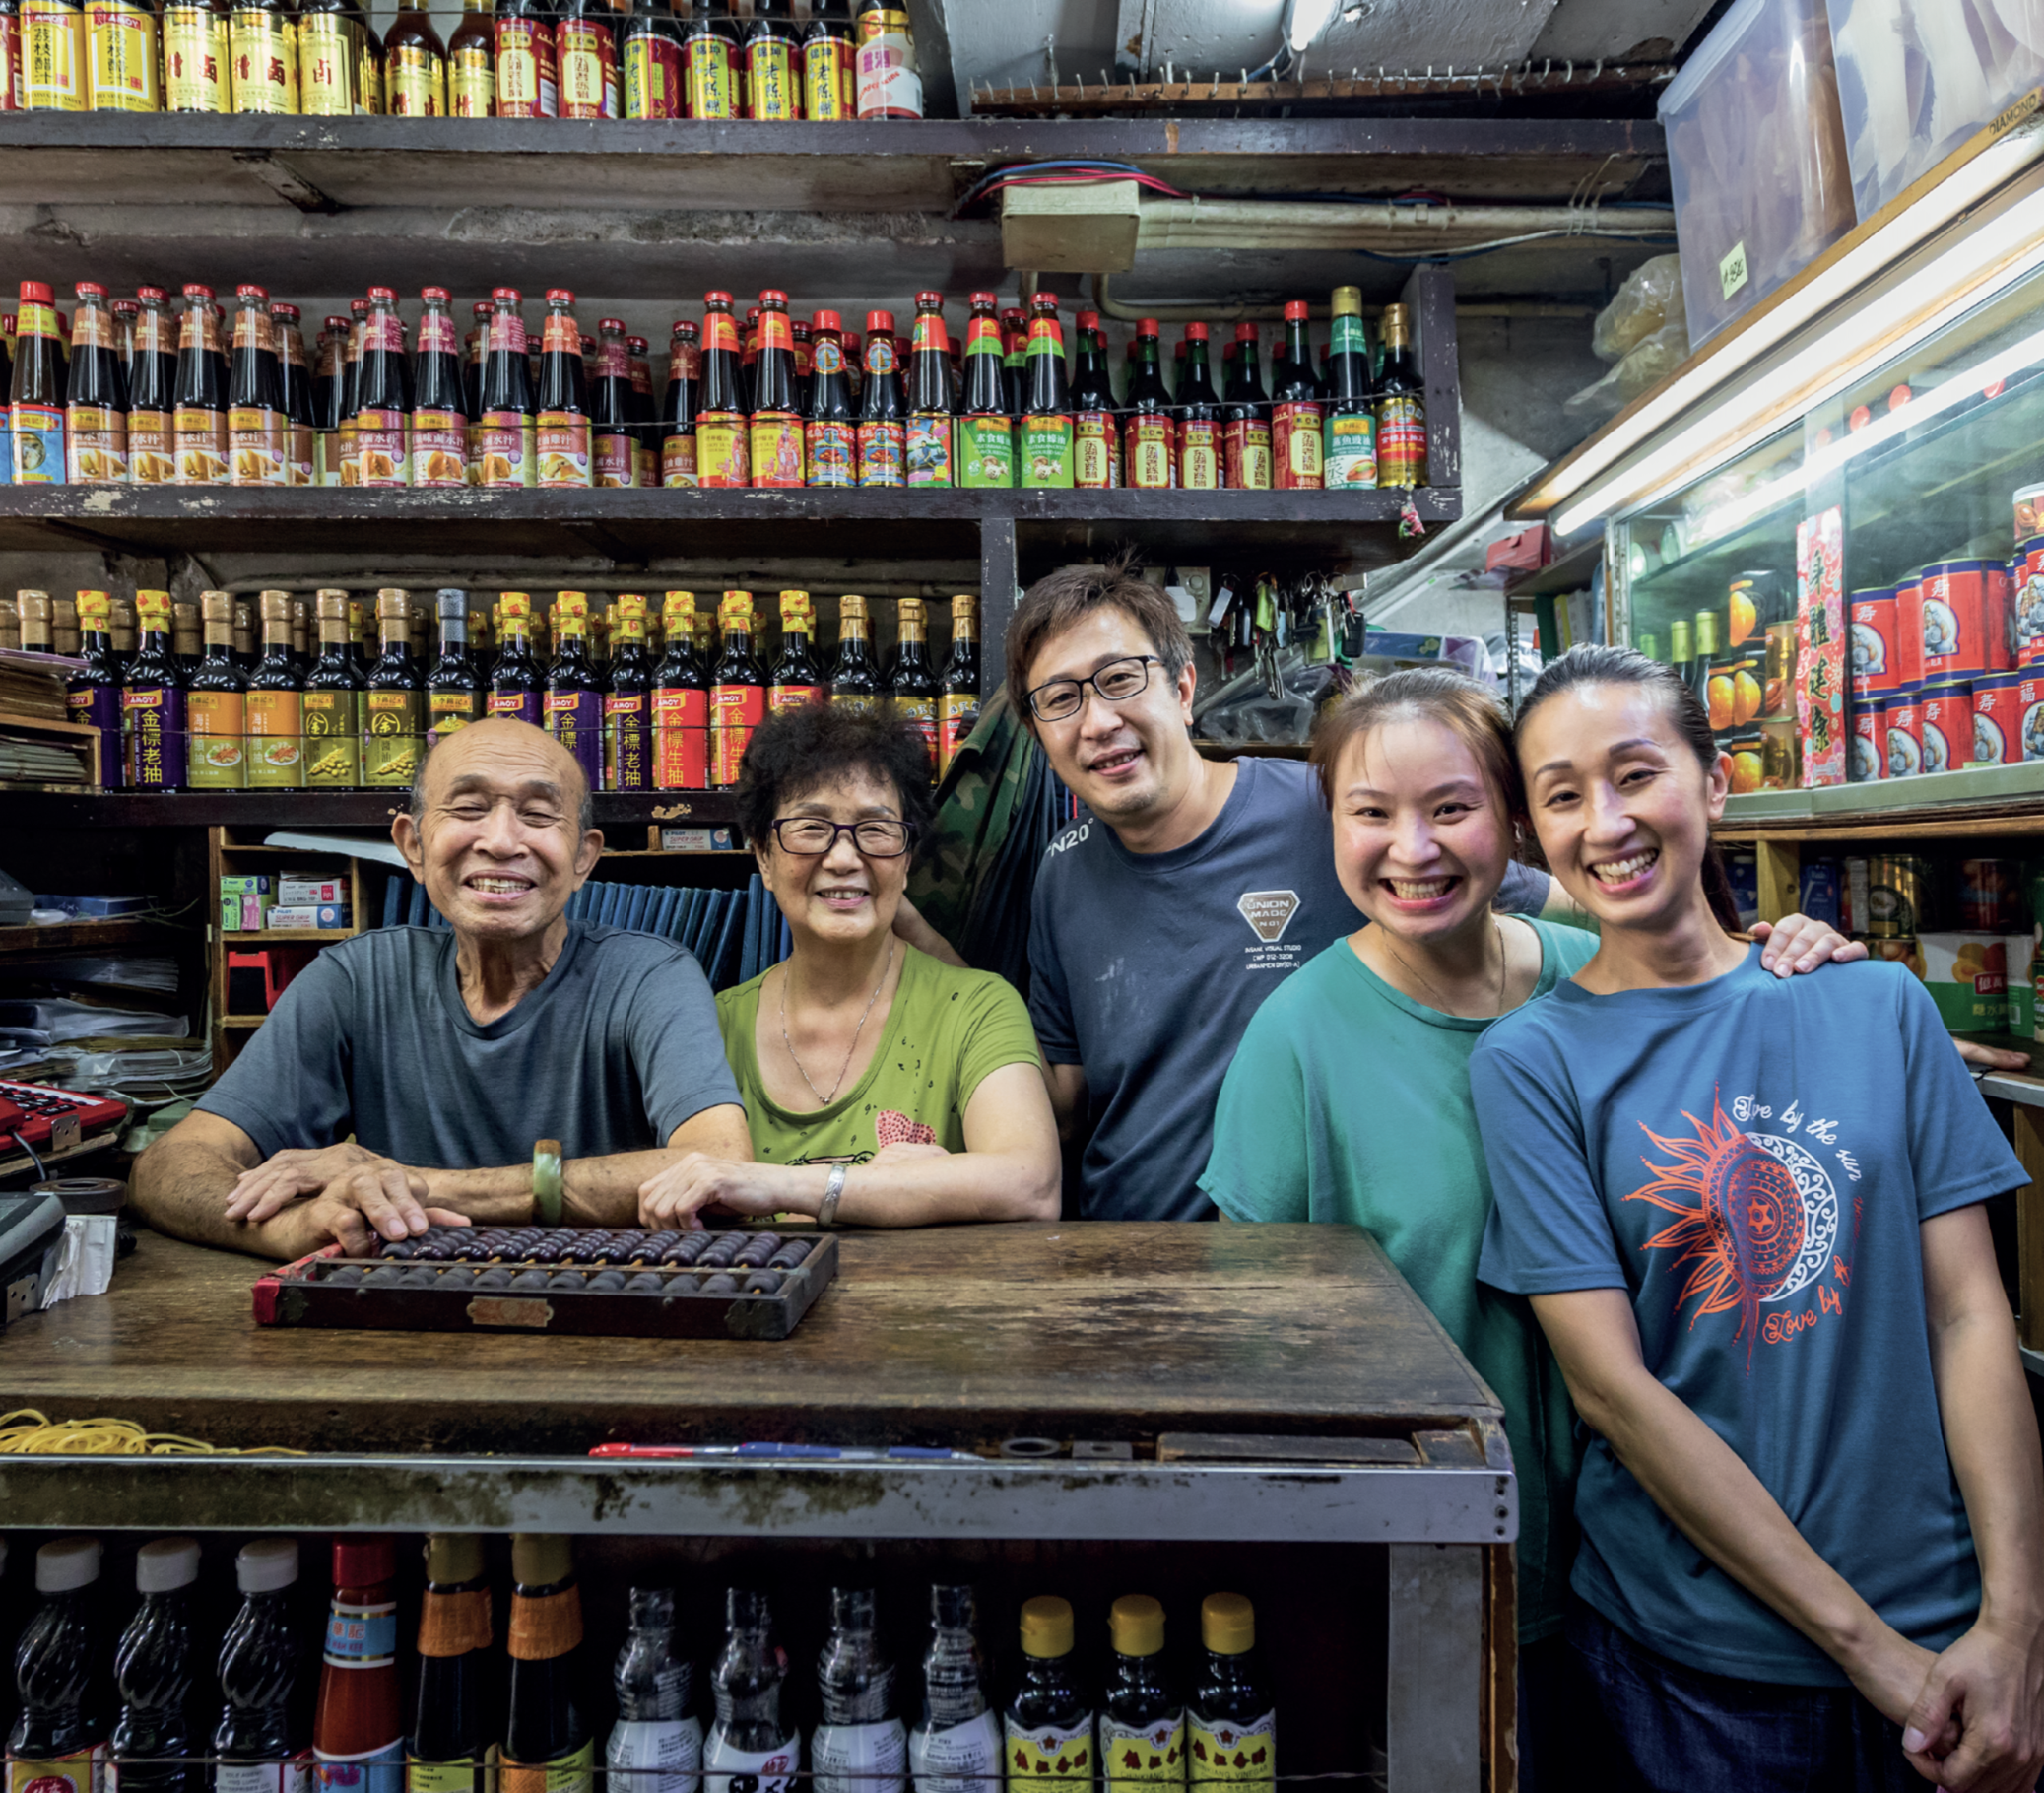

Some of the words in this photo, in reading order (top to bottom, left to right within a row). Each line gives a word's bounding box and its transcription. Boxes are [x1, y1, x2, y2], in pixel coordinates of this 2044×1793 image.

[34, 14, 66, 25] AMOY
[107, 13, 139, 28] AMOY
[1808, 549, 1831, 754] 身體健康
[141, 708, 162, 784] 金標老抽
[624, 714, 641, 787] 金標老抽
[667, 711, 684, 785] 金標生抽
[1246, 900, 1290, 910] UNION
[1779, 1099, 1804, 1134] by
[1805, 1118, 1839, 1145] the
[1835, 1149, 1862, 1182] sun
[1762, 1309, 1818, 1345] Love
[1818, 1284, 1843, 1316] by
